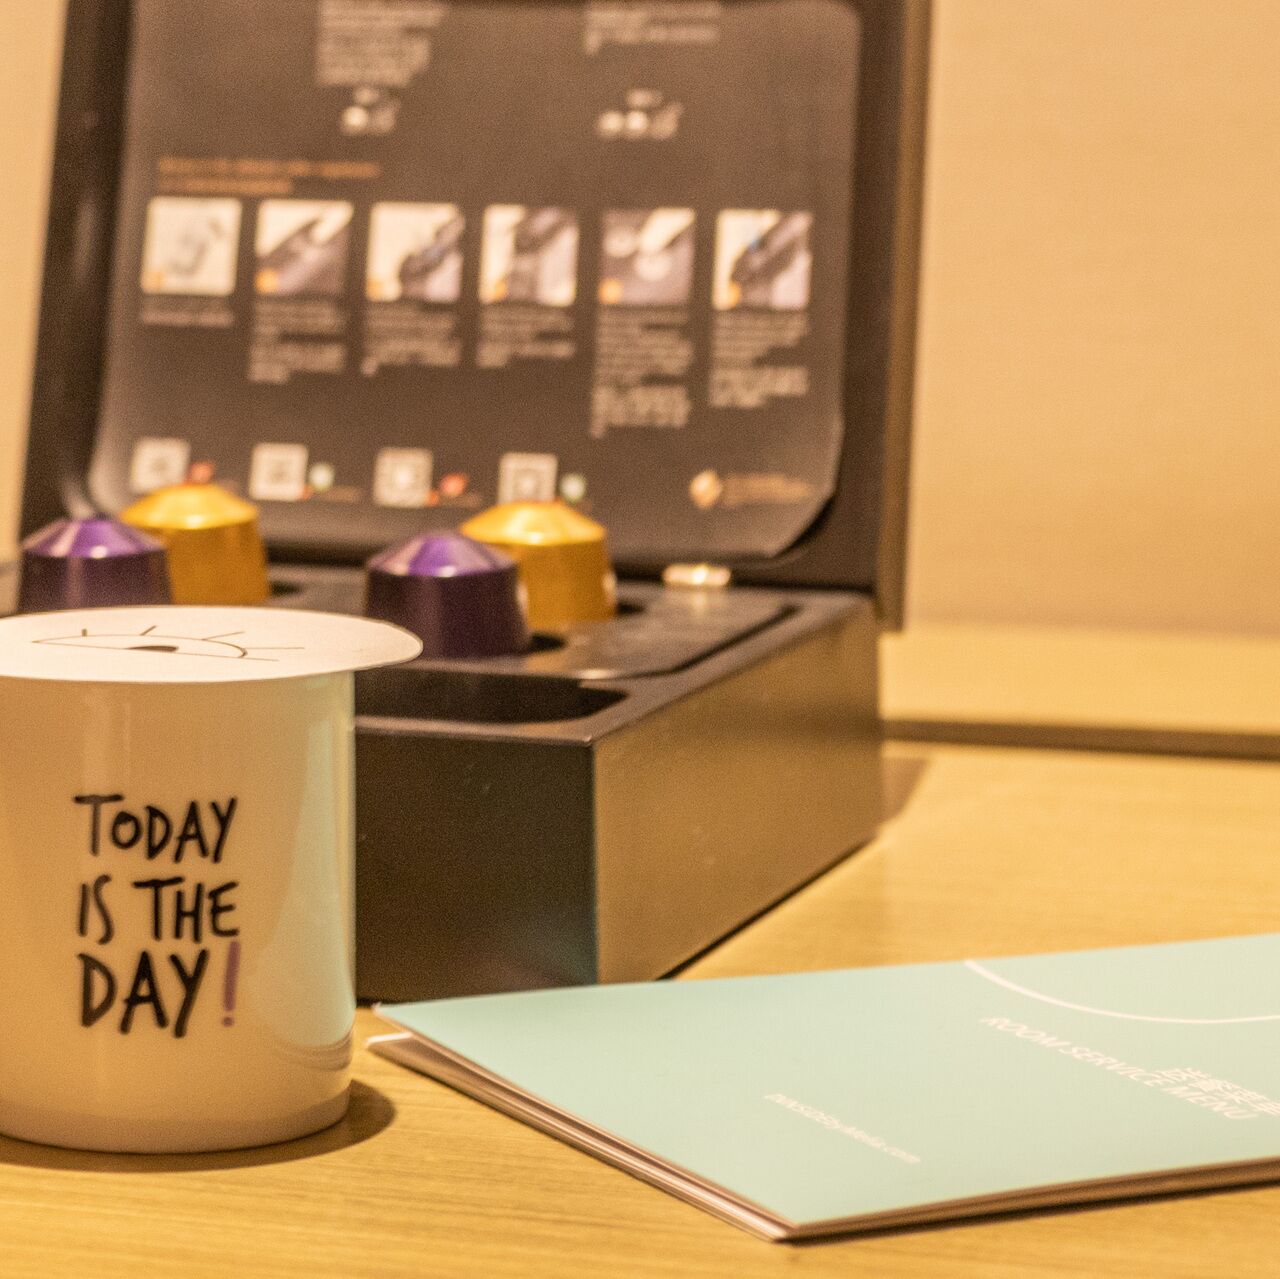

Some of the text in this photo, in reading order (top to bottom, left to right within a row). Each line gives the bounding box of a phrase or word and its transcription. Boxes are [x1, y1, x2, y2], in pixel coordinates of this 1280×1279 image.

[73, 794, 238, 864] TODAY
[77, 874, 240, 945] IS THE
[76, 940, 240, 1039] DAY!
[980, 1017, 1259, 1120] ROOM SERVICE MENU
